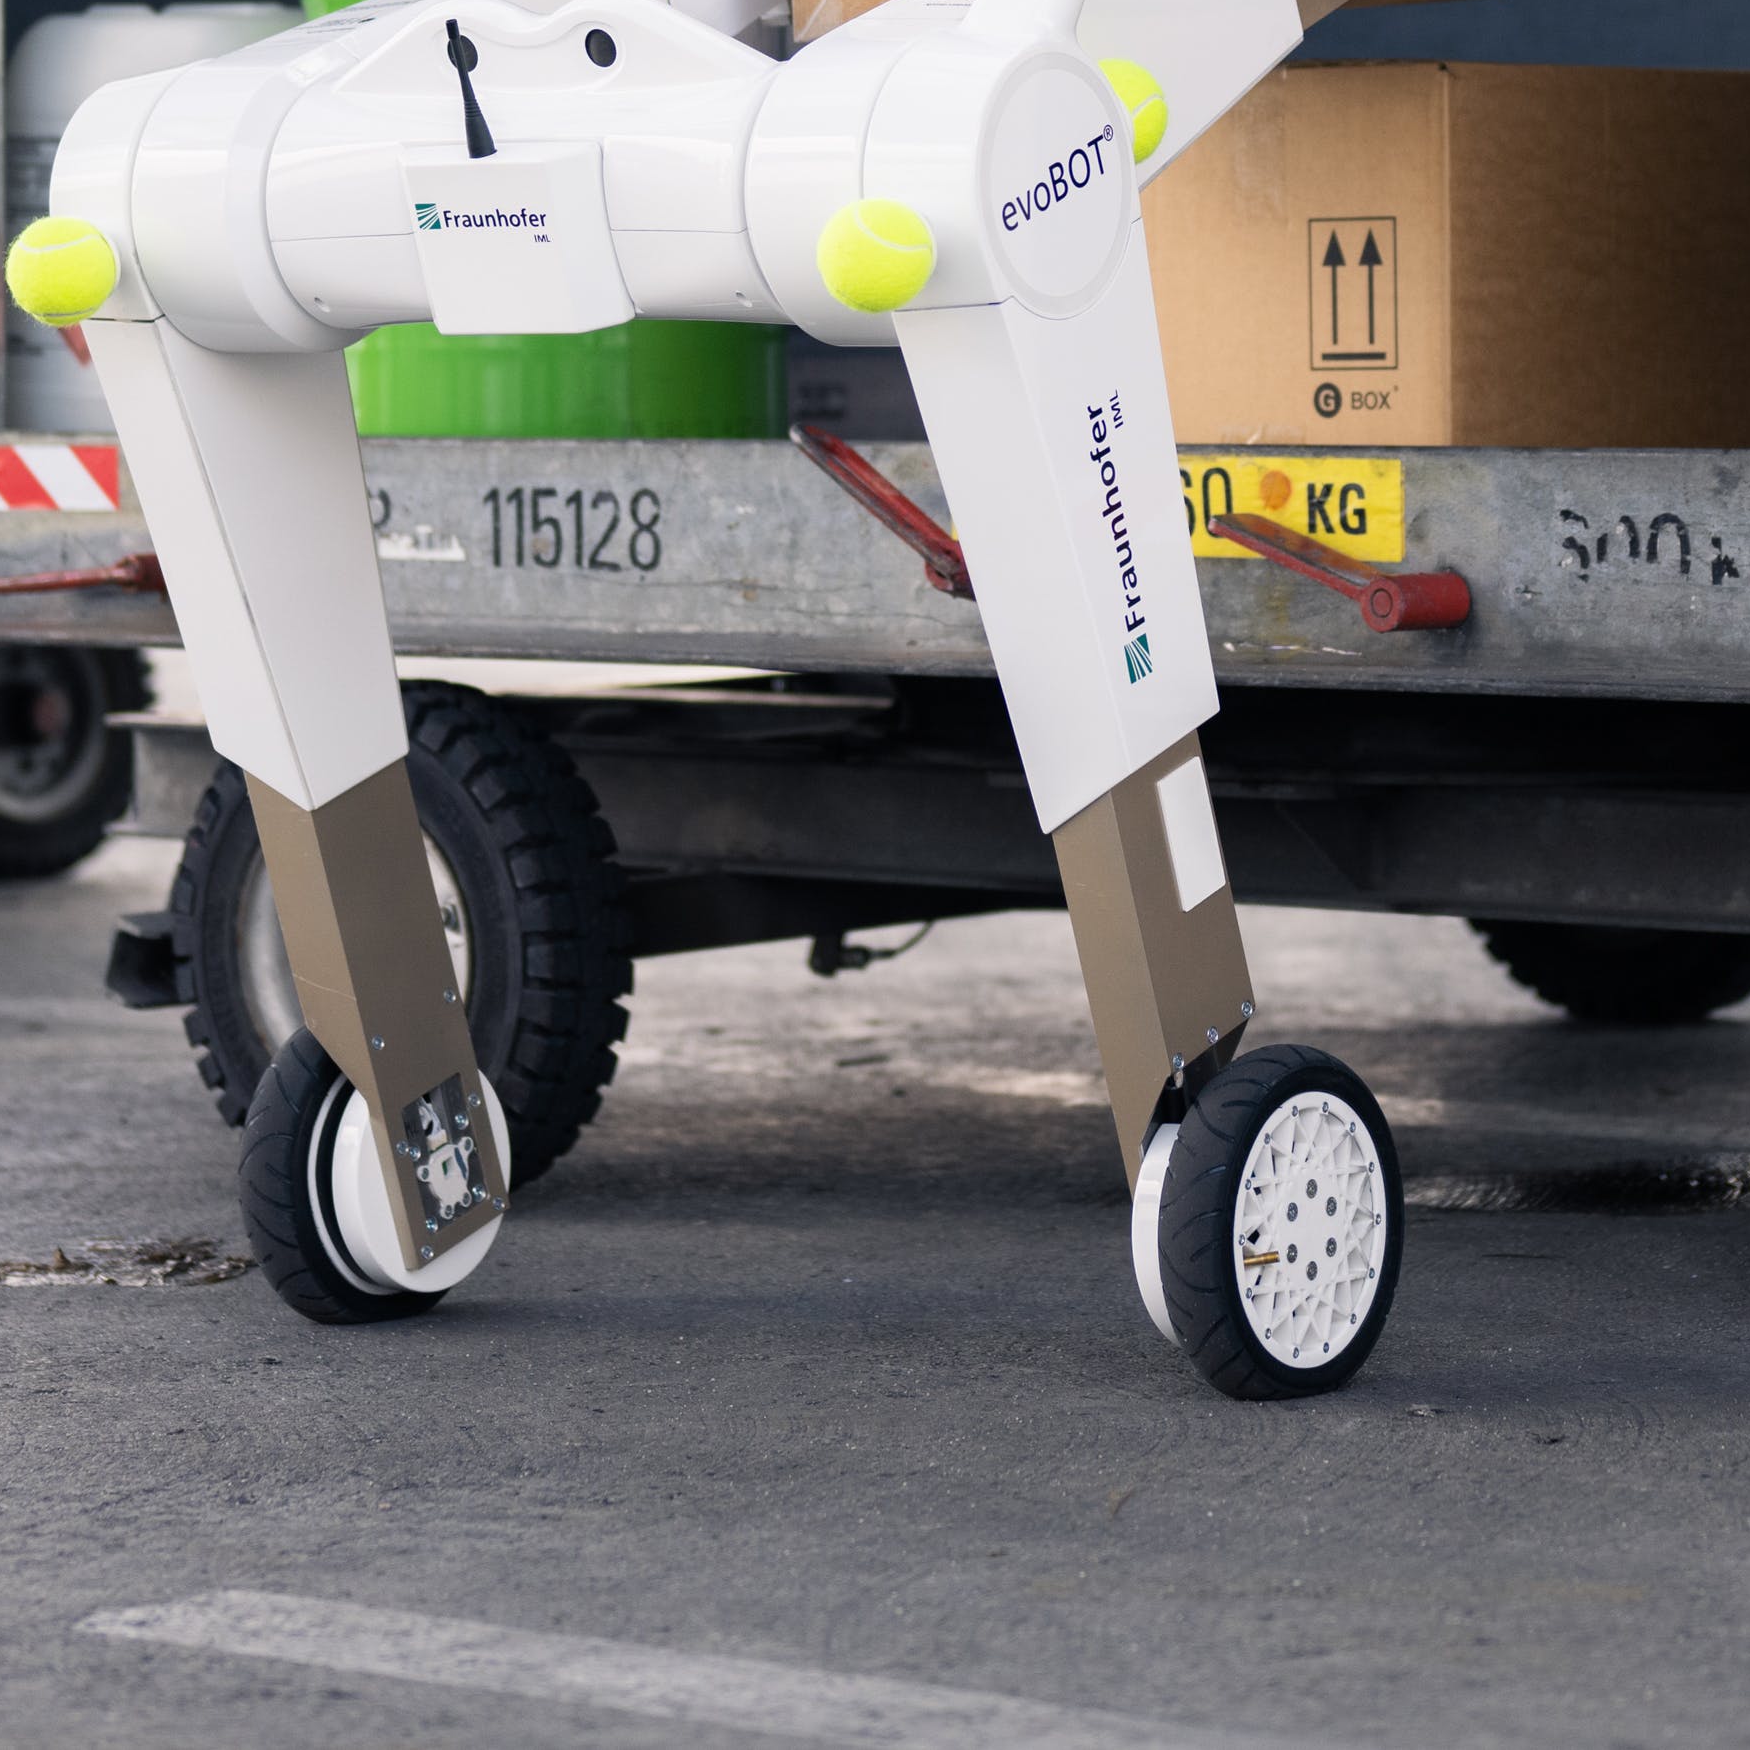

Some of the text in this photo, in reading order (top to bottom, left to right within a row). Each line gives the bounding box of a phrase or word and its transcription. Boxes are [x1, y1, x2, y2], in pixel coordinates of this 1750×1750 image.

[443, 208, 547, 229] Fraunhofer
[534, 234, 552, 243] IML
[1109, 388, 1124, 430] IML
[484, 487, 662, 572] 115128
[1086, 404, 1146, 633] Fraunhofer
[1307, 481, 1368, 536] KG
